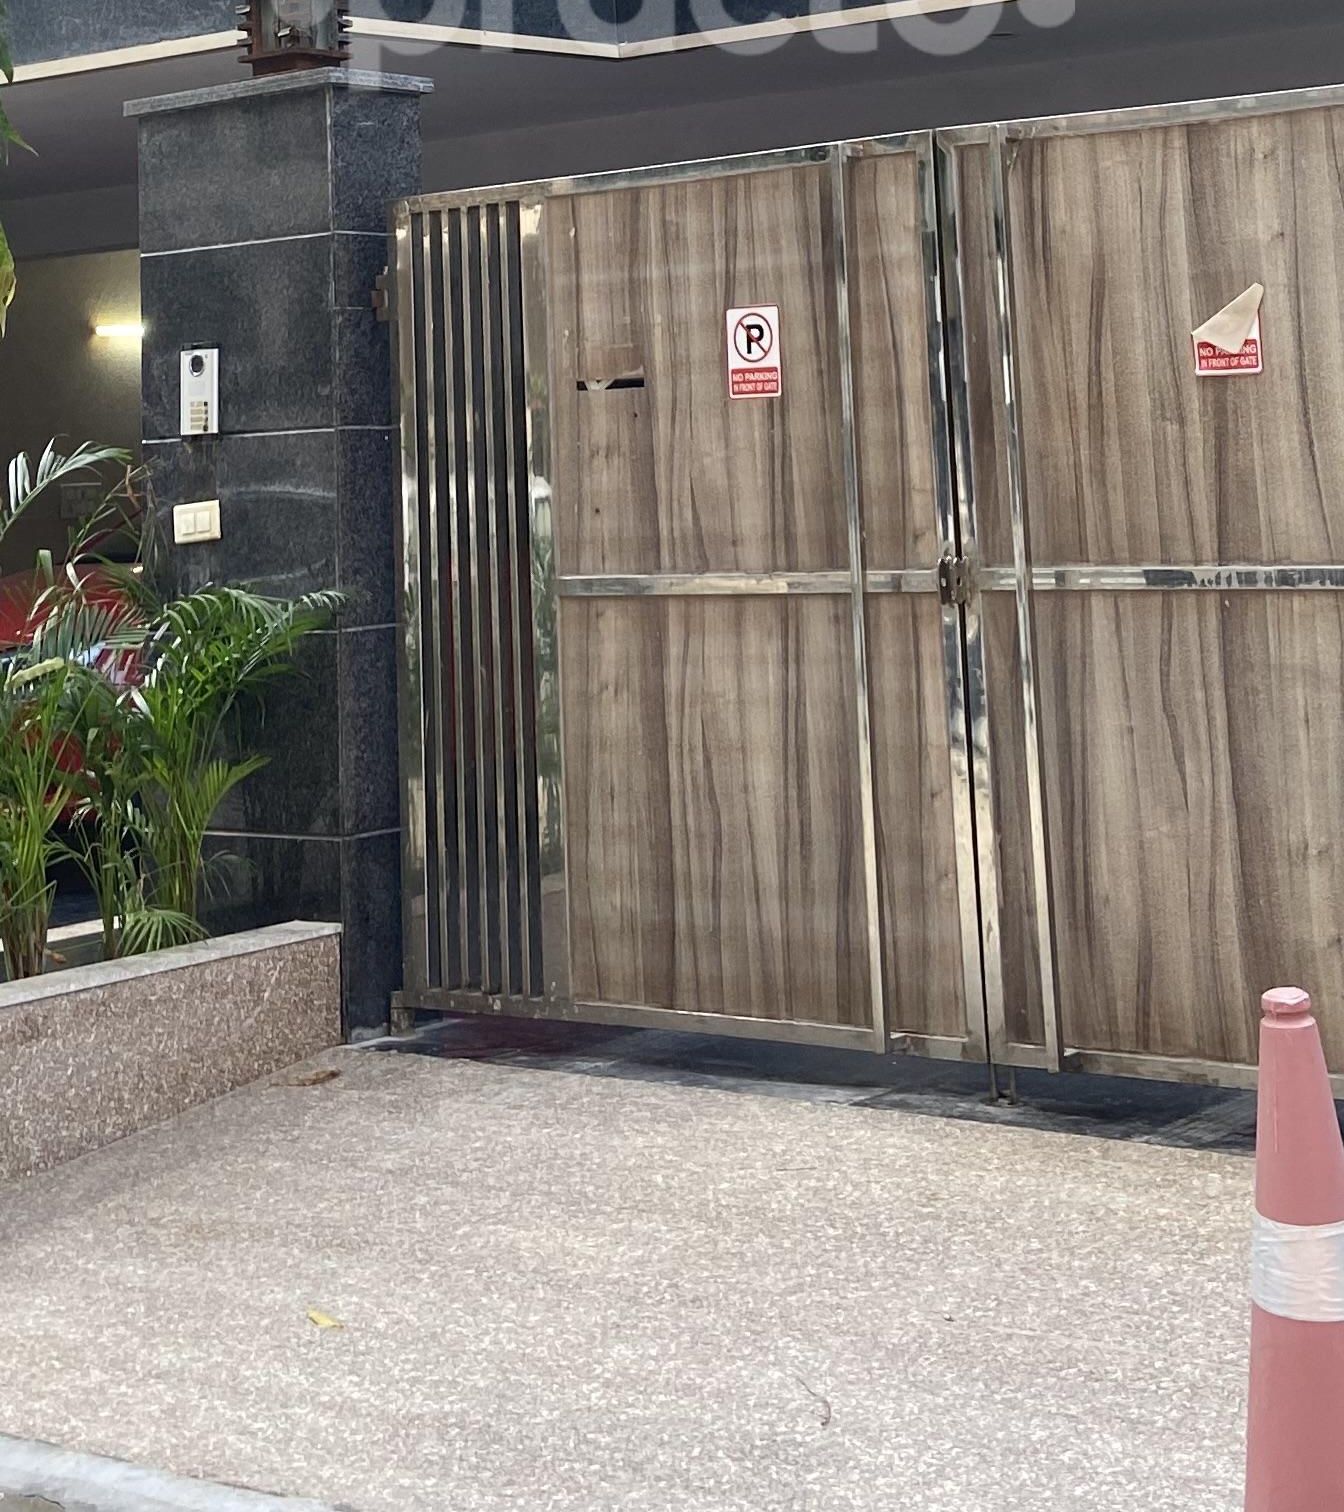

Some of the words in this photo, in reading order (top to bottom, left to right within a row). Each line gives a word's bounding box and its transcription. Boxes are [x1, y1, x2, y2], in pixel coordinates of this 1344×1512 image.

[746, 324, 764, 354] P
[1199, 347, 1214, 357] NO
[1200, 359, 1207, 368] IN
[1208, 358, 1229, 368] FRONT
[1229, 356, 1240, 366] OF
[1240, 355, 1258, 366] GATE
[732, 373, 744, 382] NO
[744, 371, 778, 381] PARKING
